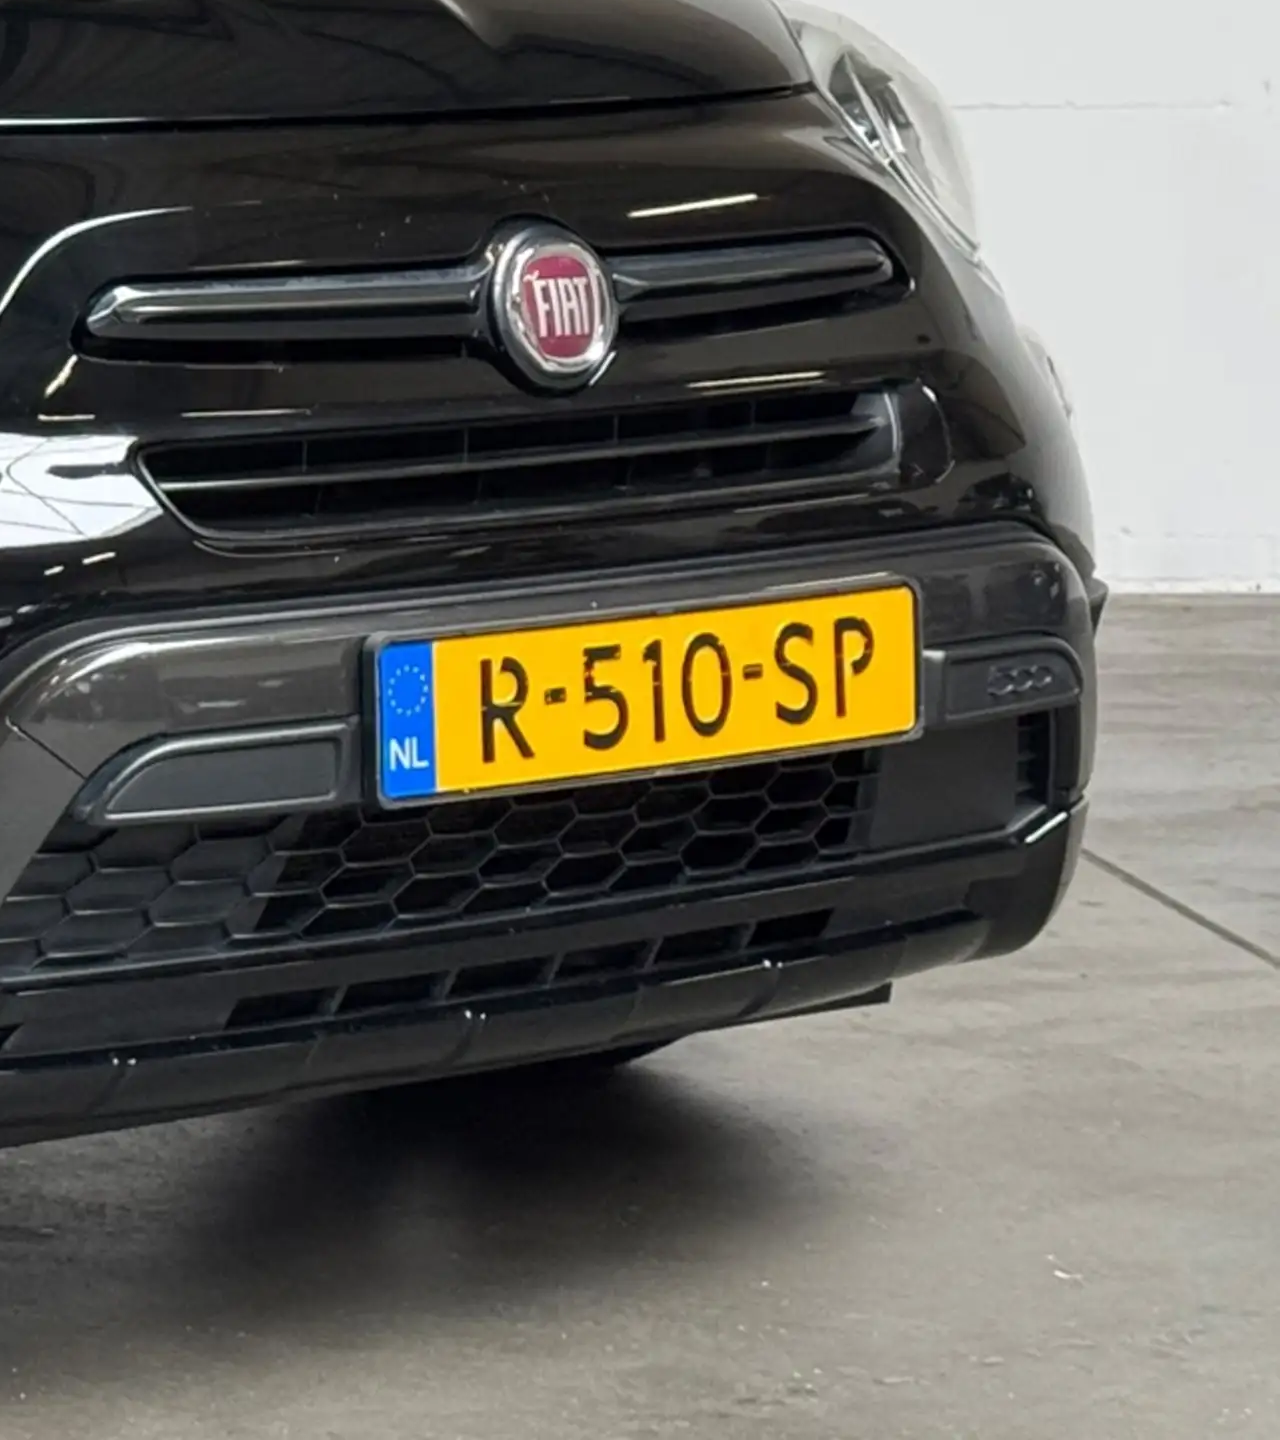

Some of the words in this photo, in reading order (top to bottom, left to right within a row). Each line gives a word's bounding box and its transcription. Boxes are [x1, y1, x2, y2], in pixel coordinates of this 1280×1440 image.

[531, 275, 590, 338] FIAT
[480, 616, 875, 764] R-510-SP
[388, 737, 430, 771] NL
